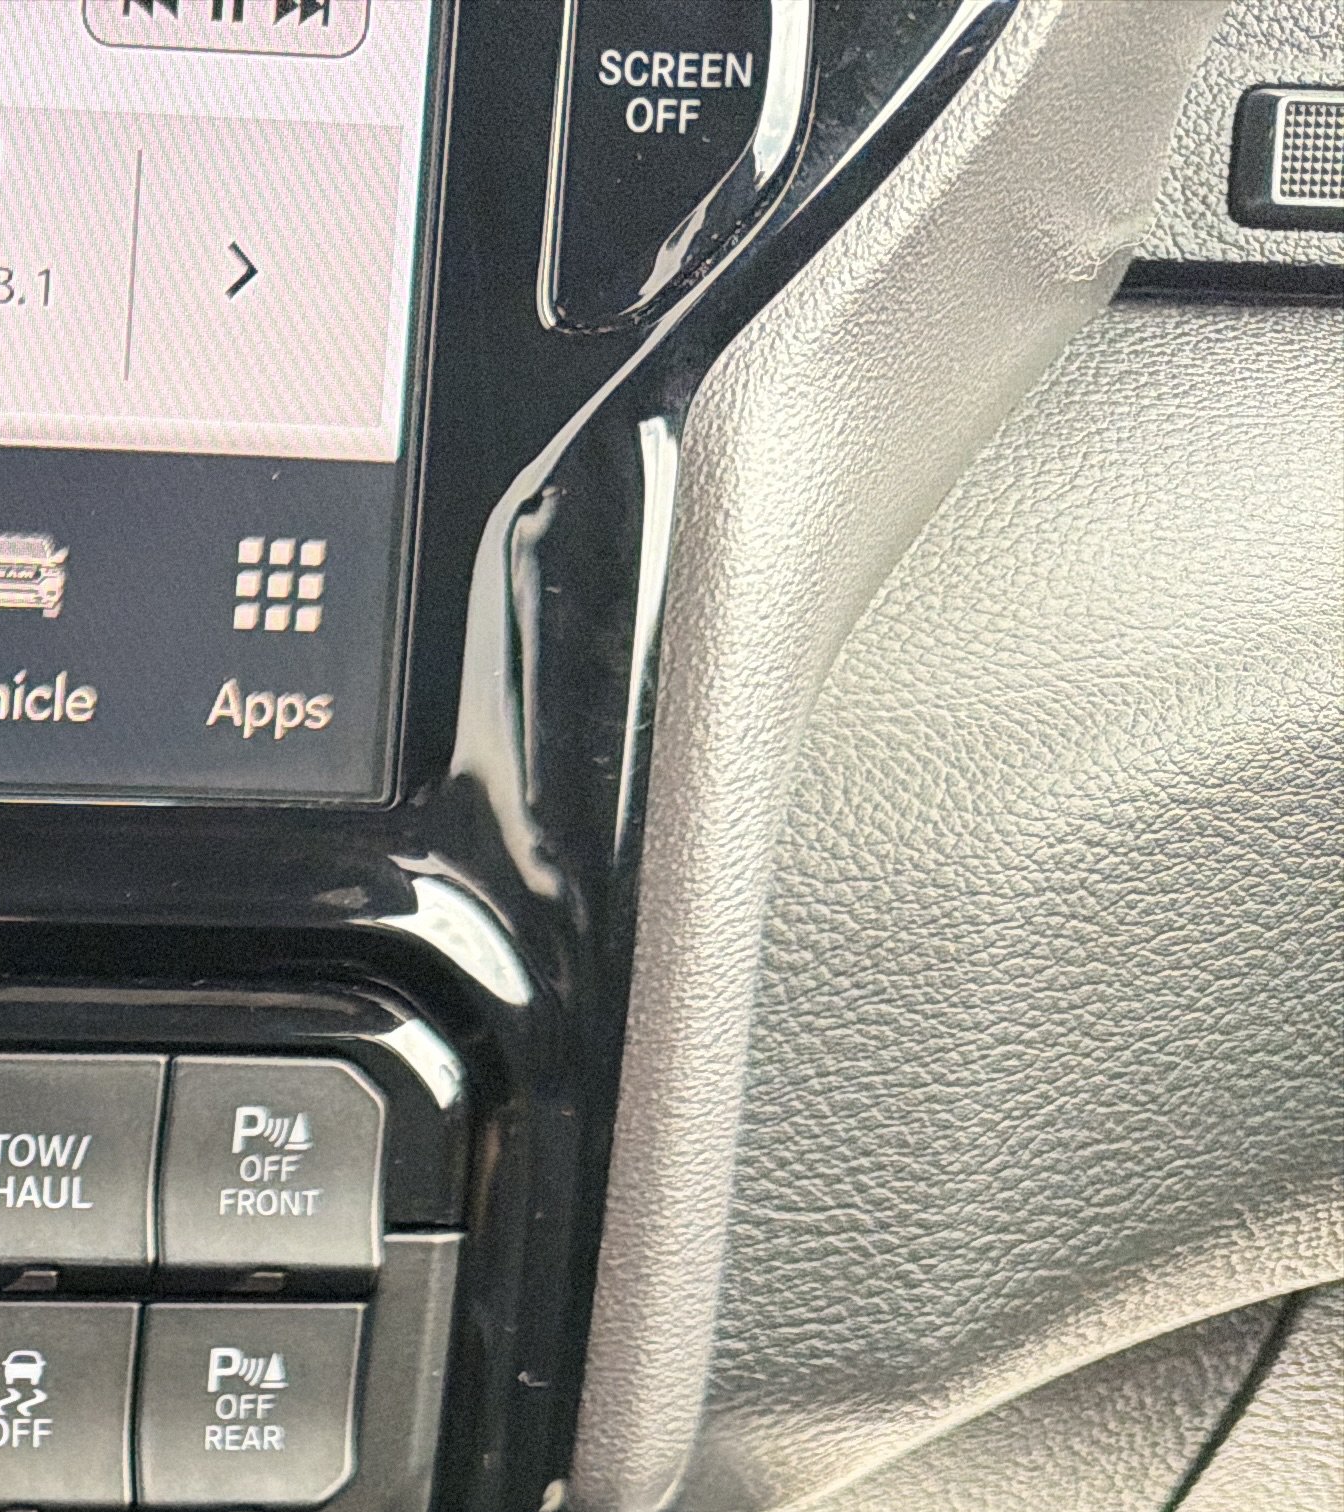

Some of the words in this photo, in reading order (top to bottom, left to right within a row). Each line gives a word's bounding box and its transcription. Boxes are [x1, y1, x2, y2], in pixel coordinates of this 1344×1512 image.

[599, 50, 753, 91] SCREEN
[625, 98, 701, 135] OFF
[207, 679, 333, 740] Apps
[239, 1155, 299, 1184] OFF
[219, 1189, 320, 1218] FRONT
[215, 1393, 275, 1422] OFF
[204, 1425, 285, 1453] REAR
